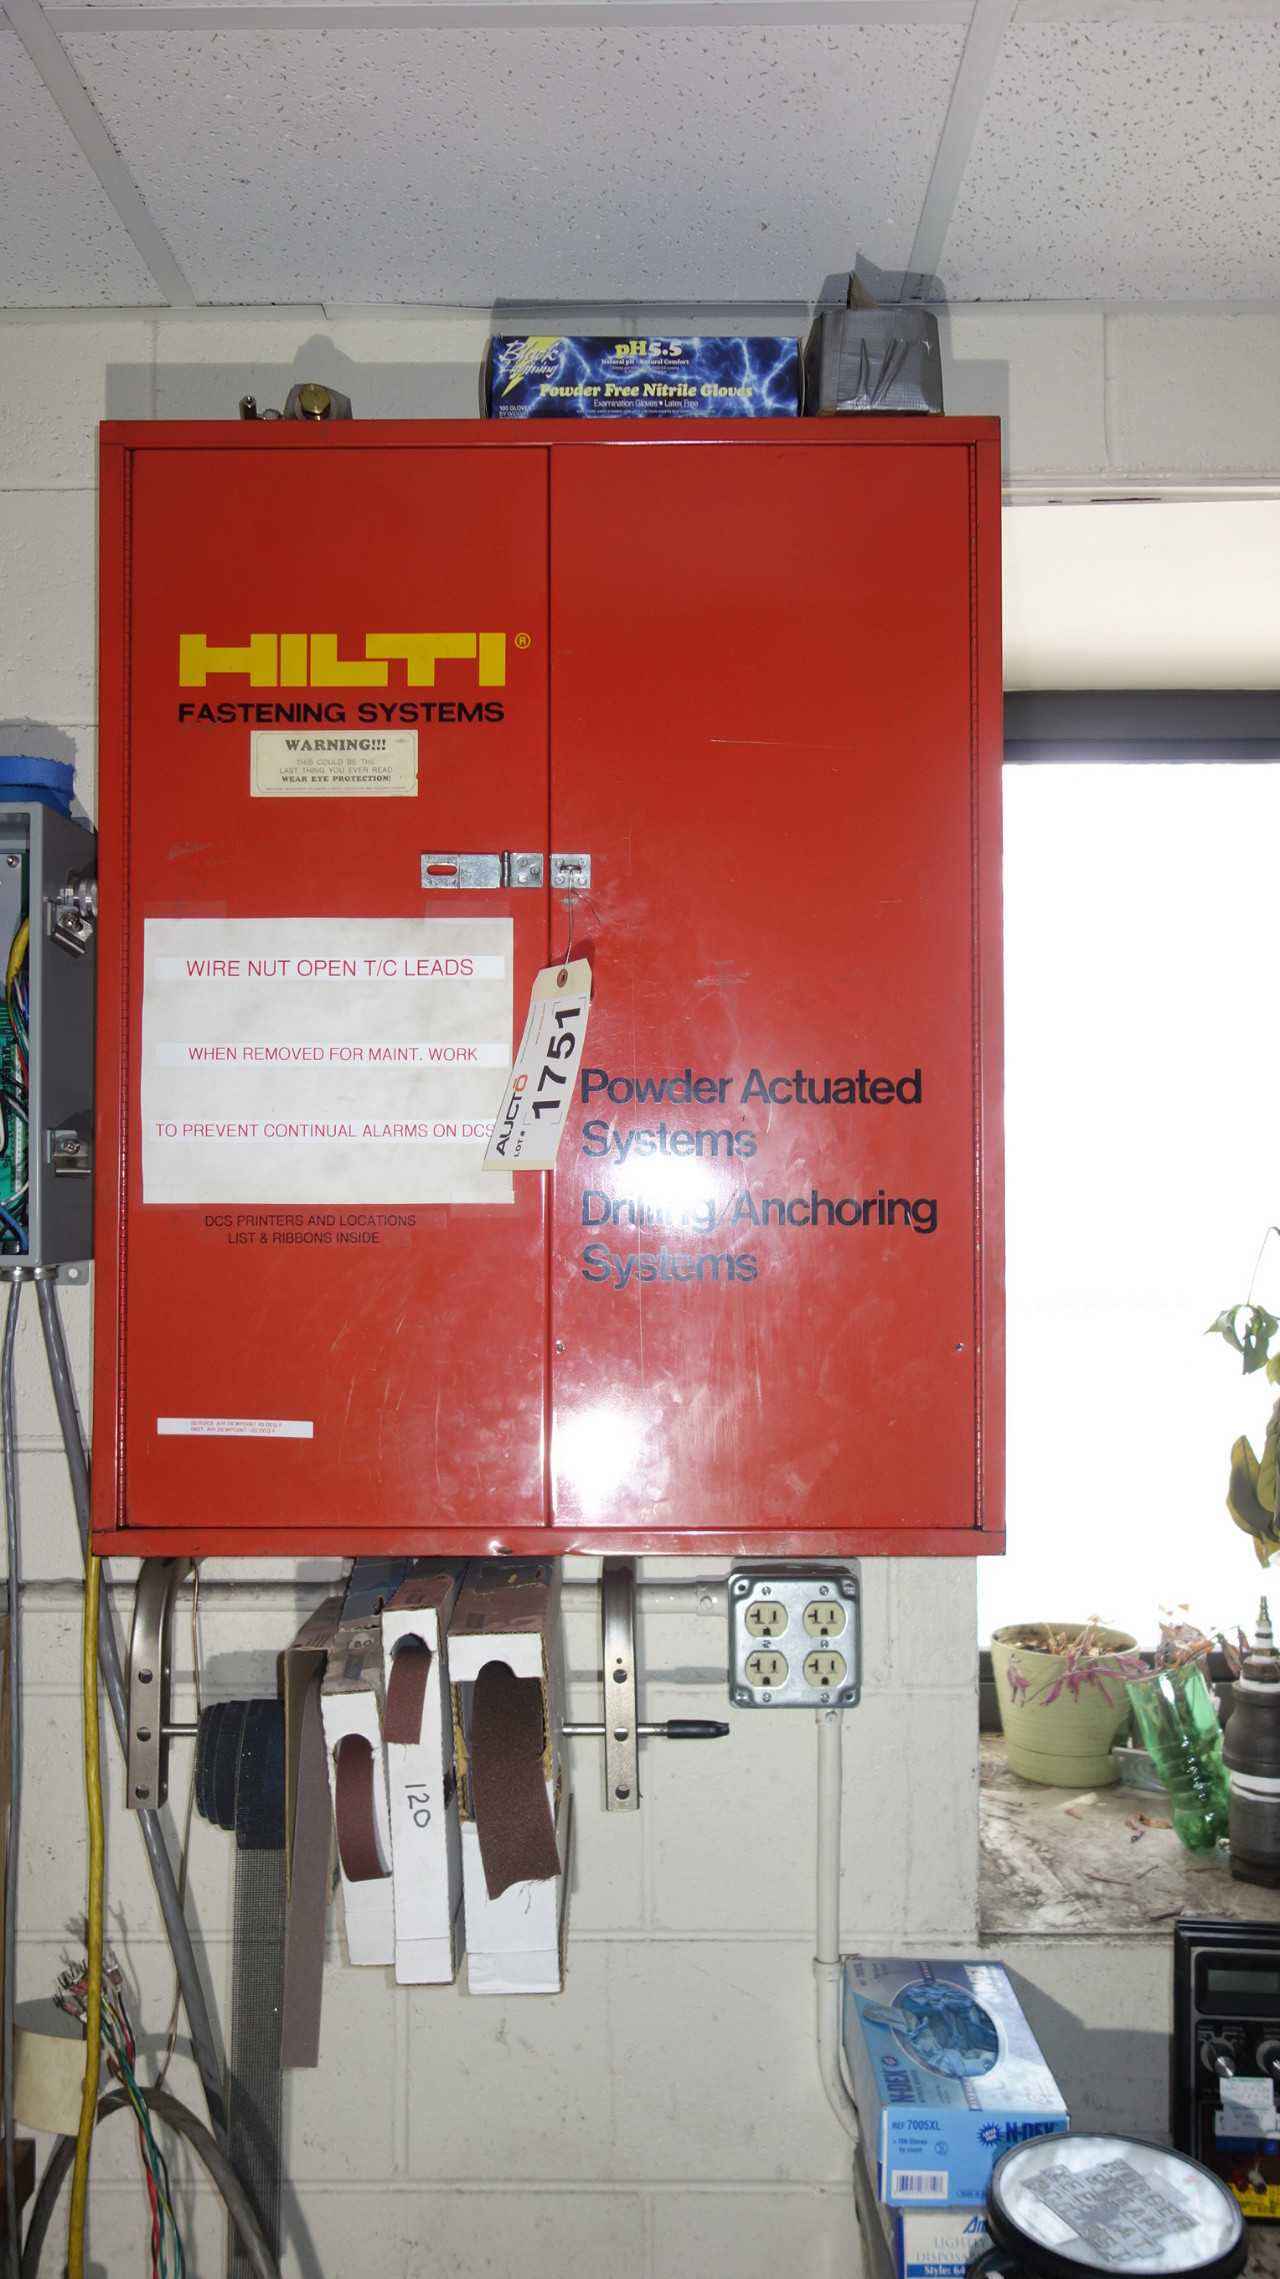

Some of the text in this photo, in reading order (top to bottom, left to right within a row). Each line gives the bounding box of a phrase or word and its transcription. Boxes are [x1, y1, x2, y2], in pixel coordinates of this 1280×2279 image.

[499, 340, 560, 361] Black
[540, 383, 753, 398] Powder Free Nitrile Gloves
[593, 399, 634, 408] Examination
[178, 632, 507, 687] HILTI
[178, 701, 505, 724] FASTENING SYSTEMS
[285, 738, 387, 751] WARNING!!!
[296, 758, 314, 766] THIS
[316, 758, 344, 766] COULD
[346, 758, 357, 766] BE
[281, 775, 308, 783] WEAR
[332, 775, 392, 783] PROTECTION!
[186, 959, 474, 977] WIRE NUT OPEN T/C LEADS
[188, 1047, 478, 1061] WHEN REMOVED FOR MAINT. WORK
[531, 1006, 581, 1120] 1751
[580, 1068, 922, 1105] Powder Actuated
[156, 1123, 495, 1138] TO PREVENT CONTINUAL ALARMS ON DCS
[581, 1120, 758, 1165] Systems
[731, 1189, 938, 1234] Anchoring
[204, 1215, 417, 1227] DCS PRINTERS AND LOCATIONS
[228, 1232, 379, 1245] LIST & RIBBONS INSIDE
[581, 1243, 759, 1290] Systems
[404, 1783, 432, 1829] 120
[907, 2119, 941, 2131] 7005XL
[924, 2266, 950, 2275] Style:
